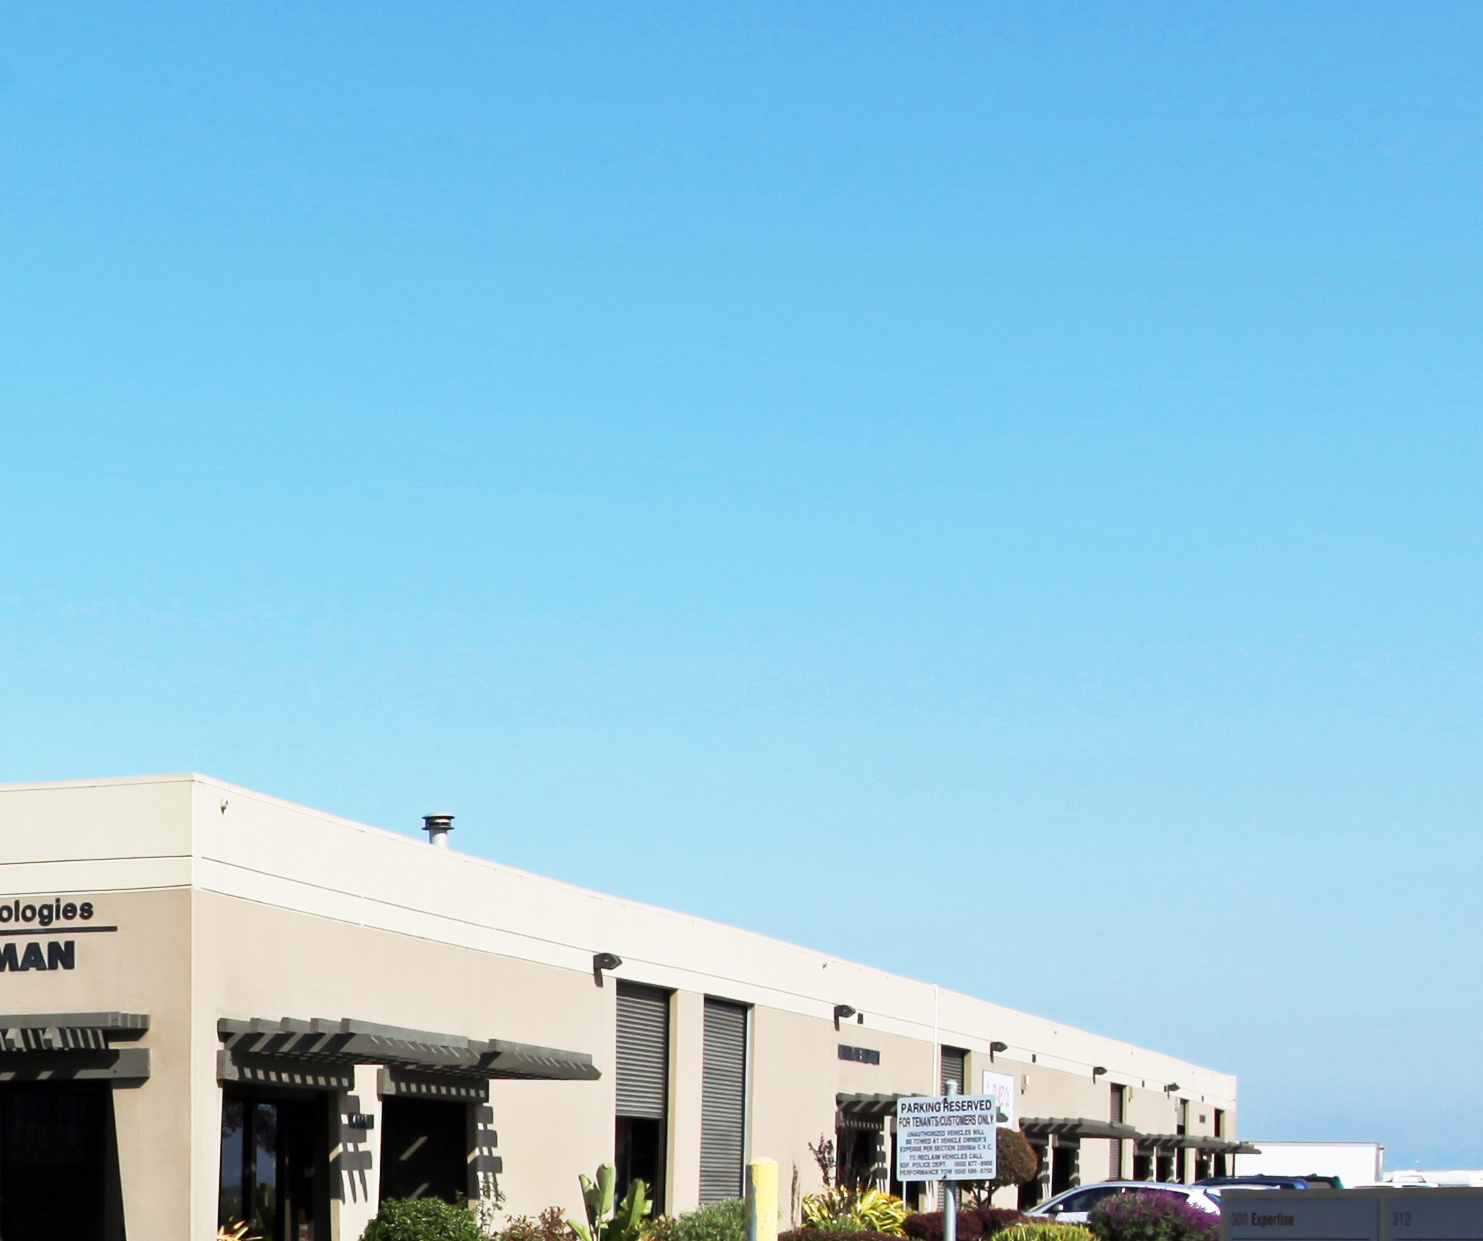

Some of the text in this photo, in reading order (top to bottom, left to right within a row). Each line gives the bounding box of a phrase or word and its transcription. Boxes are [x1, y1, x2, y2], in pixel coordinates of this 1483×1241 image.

[901, 1100, 992, 1113] PARKING RESERVED
[899, 1117, 910, 1127] FOR
[977, 1114, 994, 1125] ONLY
[1250, 1213, 1294, 1228] Expertise
[1392, 1212, 1411, 1226] 312
